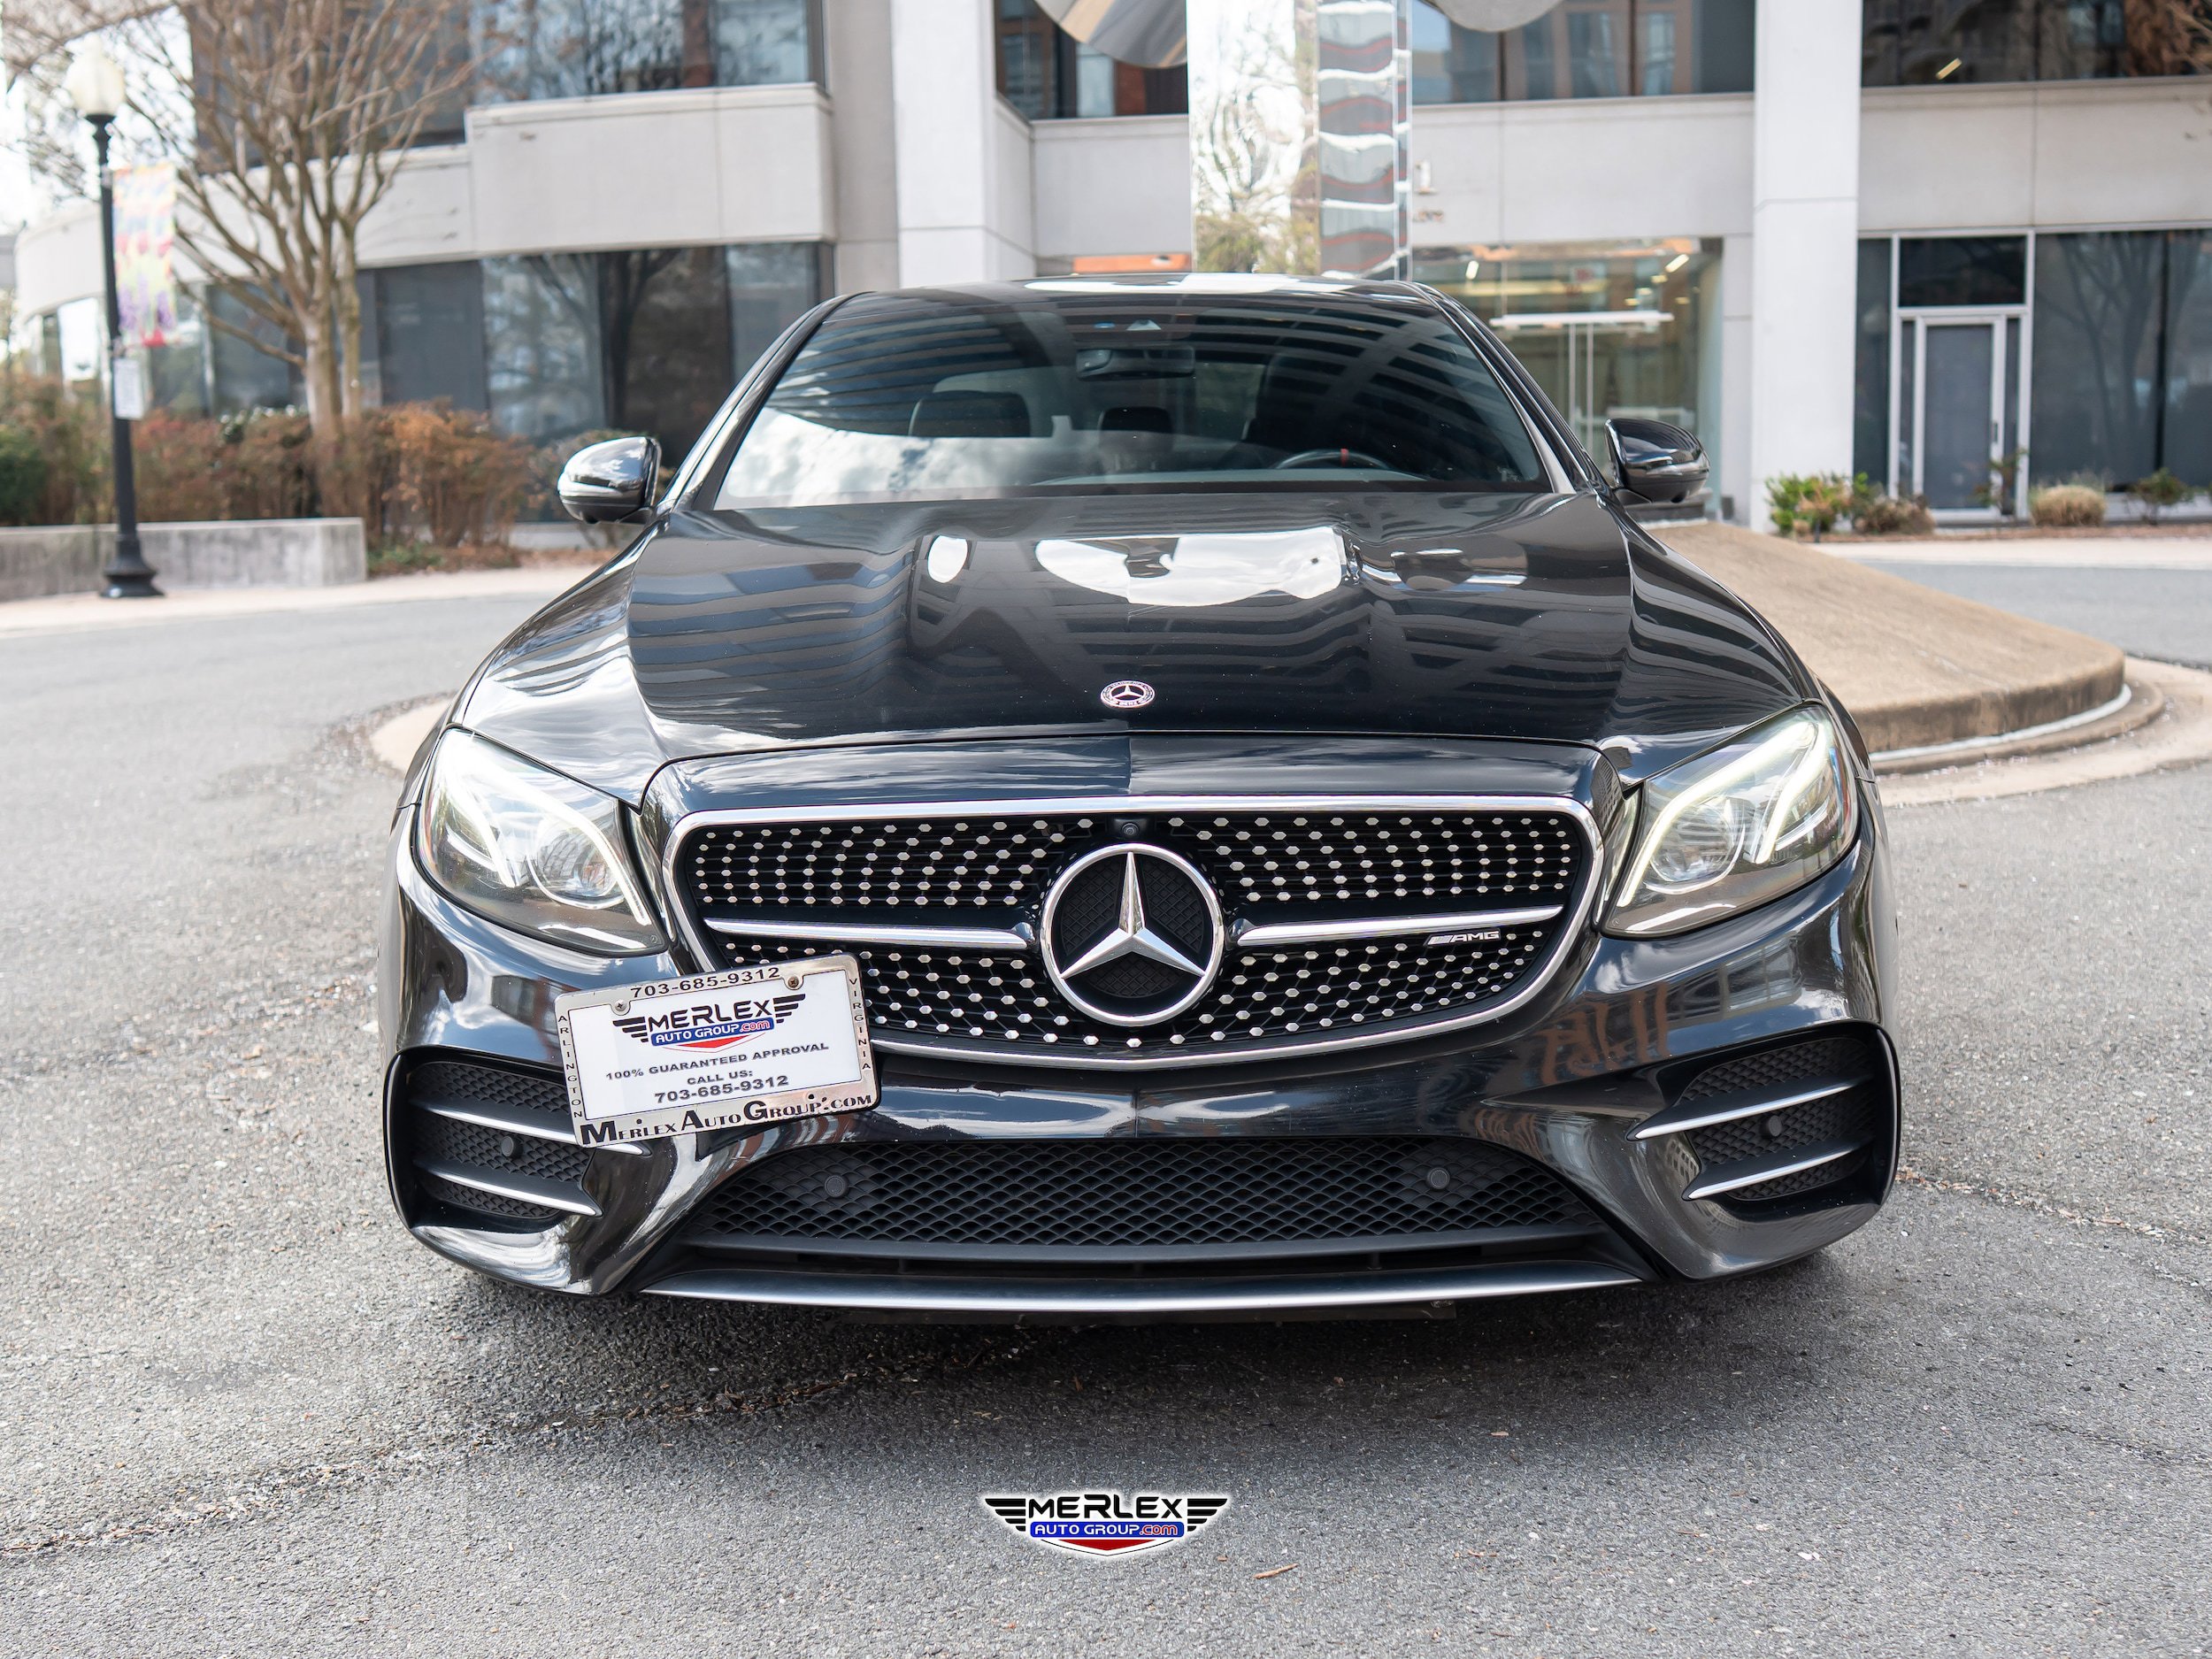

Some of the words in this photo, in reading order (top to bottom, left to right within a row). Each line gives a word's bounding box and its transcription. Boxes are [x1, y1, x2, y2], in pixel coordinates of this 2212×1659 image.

[1450, 931, 1499, 943] AMG
[630, 967, 780, 998] 703-685-9312
[649, 1000, 772, 1033] MERLEX
[655, 1030, 692, 1043] AUTO
[694, 1020, 771, 1039] GROUP.com
[849, 979, 871, 1071] VIRGINIA
[557, 1015, 583, 1118] ARLINGTON
[605, 1069, 644, 1080] 100%
[649, 1053, 747, 1074] GUARANTEED
[752, 1042, 829, 1060] APPROVAL
[654, 1075, 789, 1104] 703-685-9312
[687, 1072, 725, 1085] CALL
[728, 1069, 753, 1079] US:
